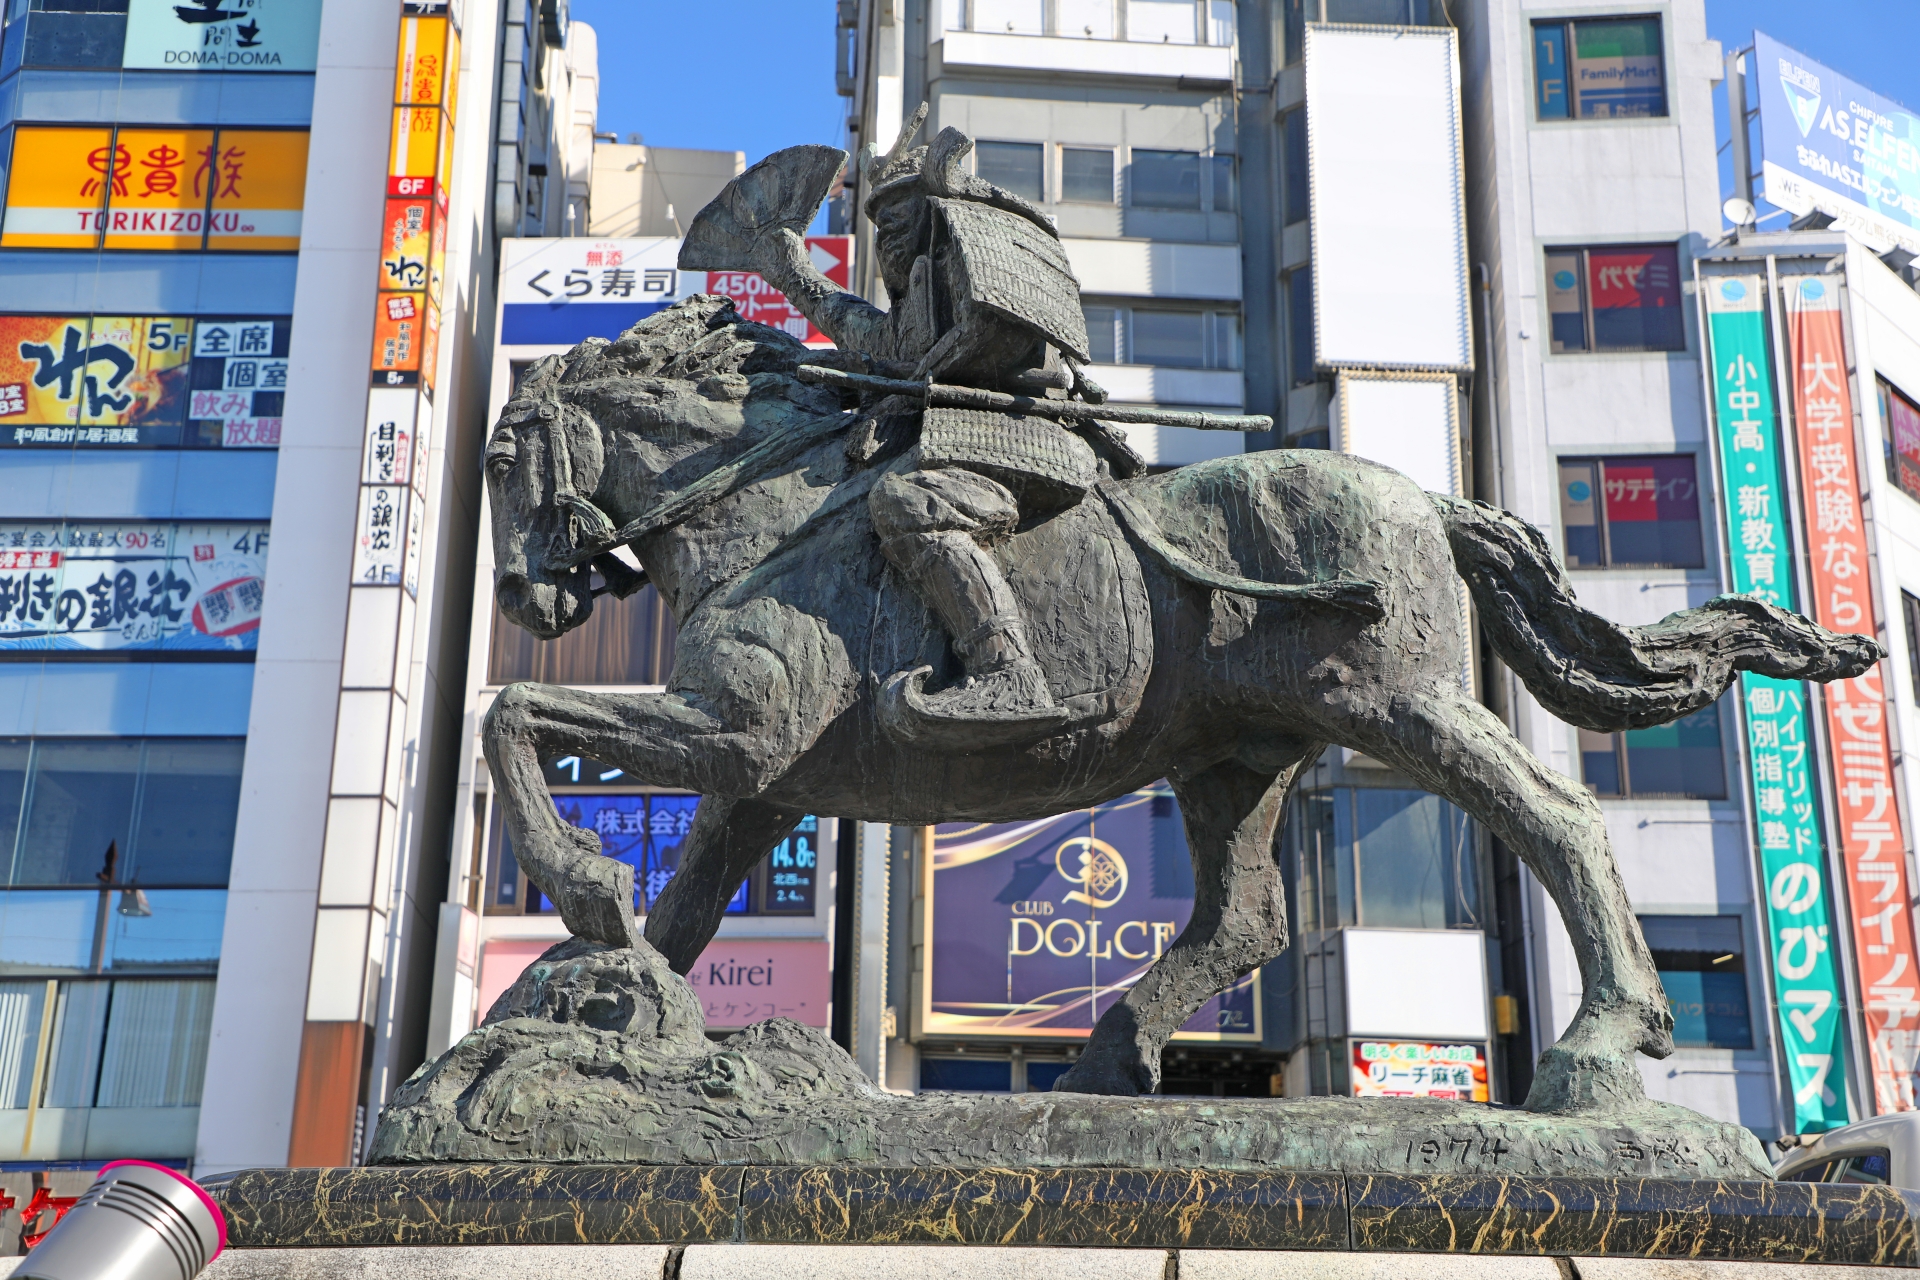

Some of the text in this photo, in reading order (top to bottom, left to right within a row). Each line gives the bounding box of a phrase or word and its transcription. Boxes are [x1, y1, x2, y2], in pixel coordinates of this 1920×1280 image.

[416, 3, 437, 14] 7F
[164, 50, 282, 65] DOMA-DOMA
[1581, 66, 1658, 80] FamilyMart
[1849, 100, 1894, 133] CHIFURE
[79, 143, 246, 199] 鳥貴族
[1853, 149, 1899, 181] SAITAMA
[398, 178, 425, 195] 6F
[78, 211, 240, 233] TORIKIZOKU
[527, 268, 678, 298] くら寿司
[1598, 264, 1670, 291] 代ゼミ
[148, 323, 188, 351] 5F
[200, 325, 269, 353] 全席
[20, 325, 135, 418] わん
[227, 361, 287, 388] 個室
[387, 371, 404, 385] 5F
[192, 391, 249, 417] 飲み
[225, 418, 281, 445] 放題
[1606, 477, 1695, 502] サテライン
[1802, 353, 1863, 627] 大学受験なら
[233, 531, 269, 554] 4F
[364, 564, 393, 581] 4F
[1749, 686, 1791, 849] 個別指導塾
[1775, 689, 1812, 855] ハイブリッド
[1011, 900, 1054, 915] CLUB
[709, 958, 773, 986] Kirei
[1770, 862, 1837, 1108] のびマス
[1676, 1001, 1745, 1017] ハウスコム
[1363, 1043, 1477, 1062] 明るく楽しいお店
[1373, 1065, 1471, 1087] リーチ麻雀
[1406, 1136, 1508, 1165] 1974
